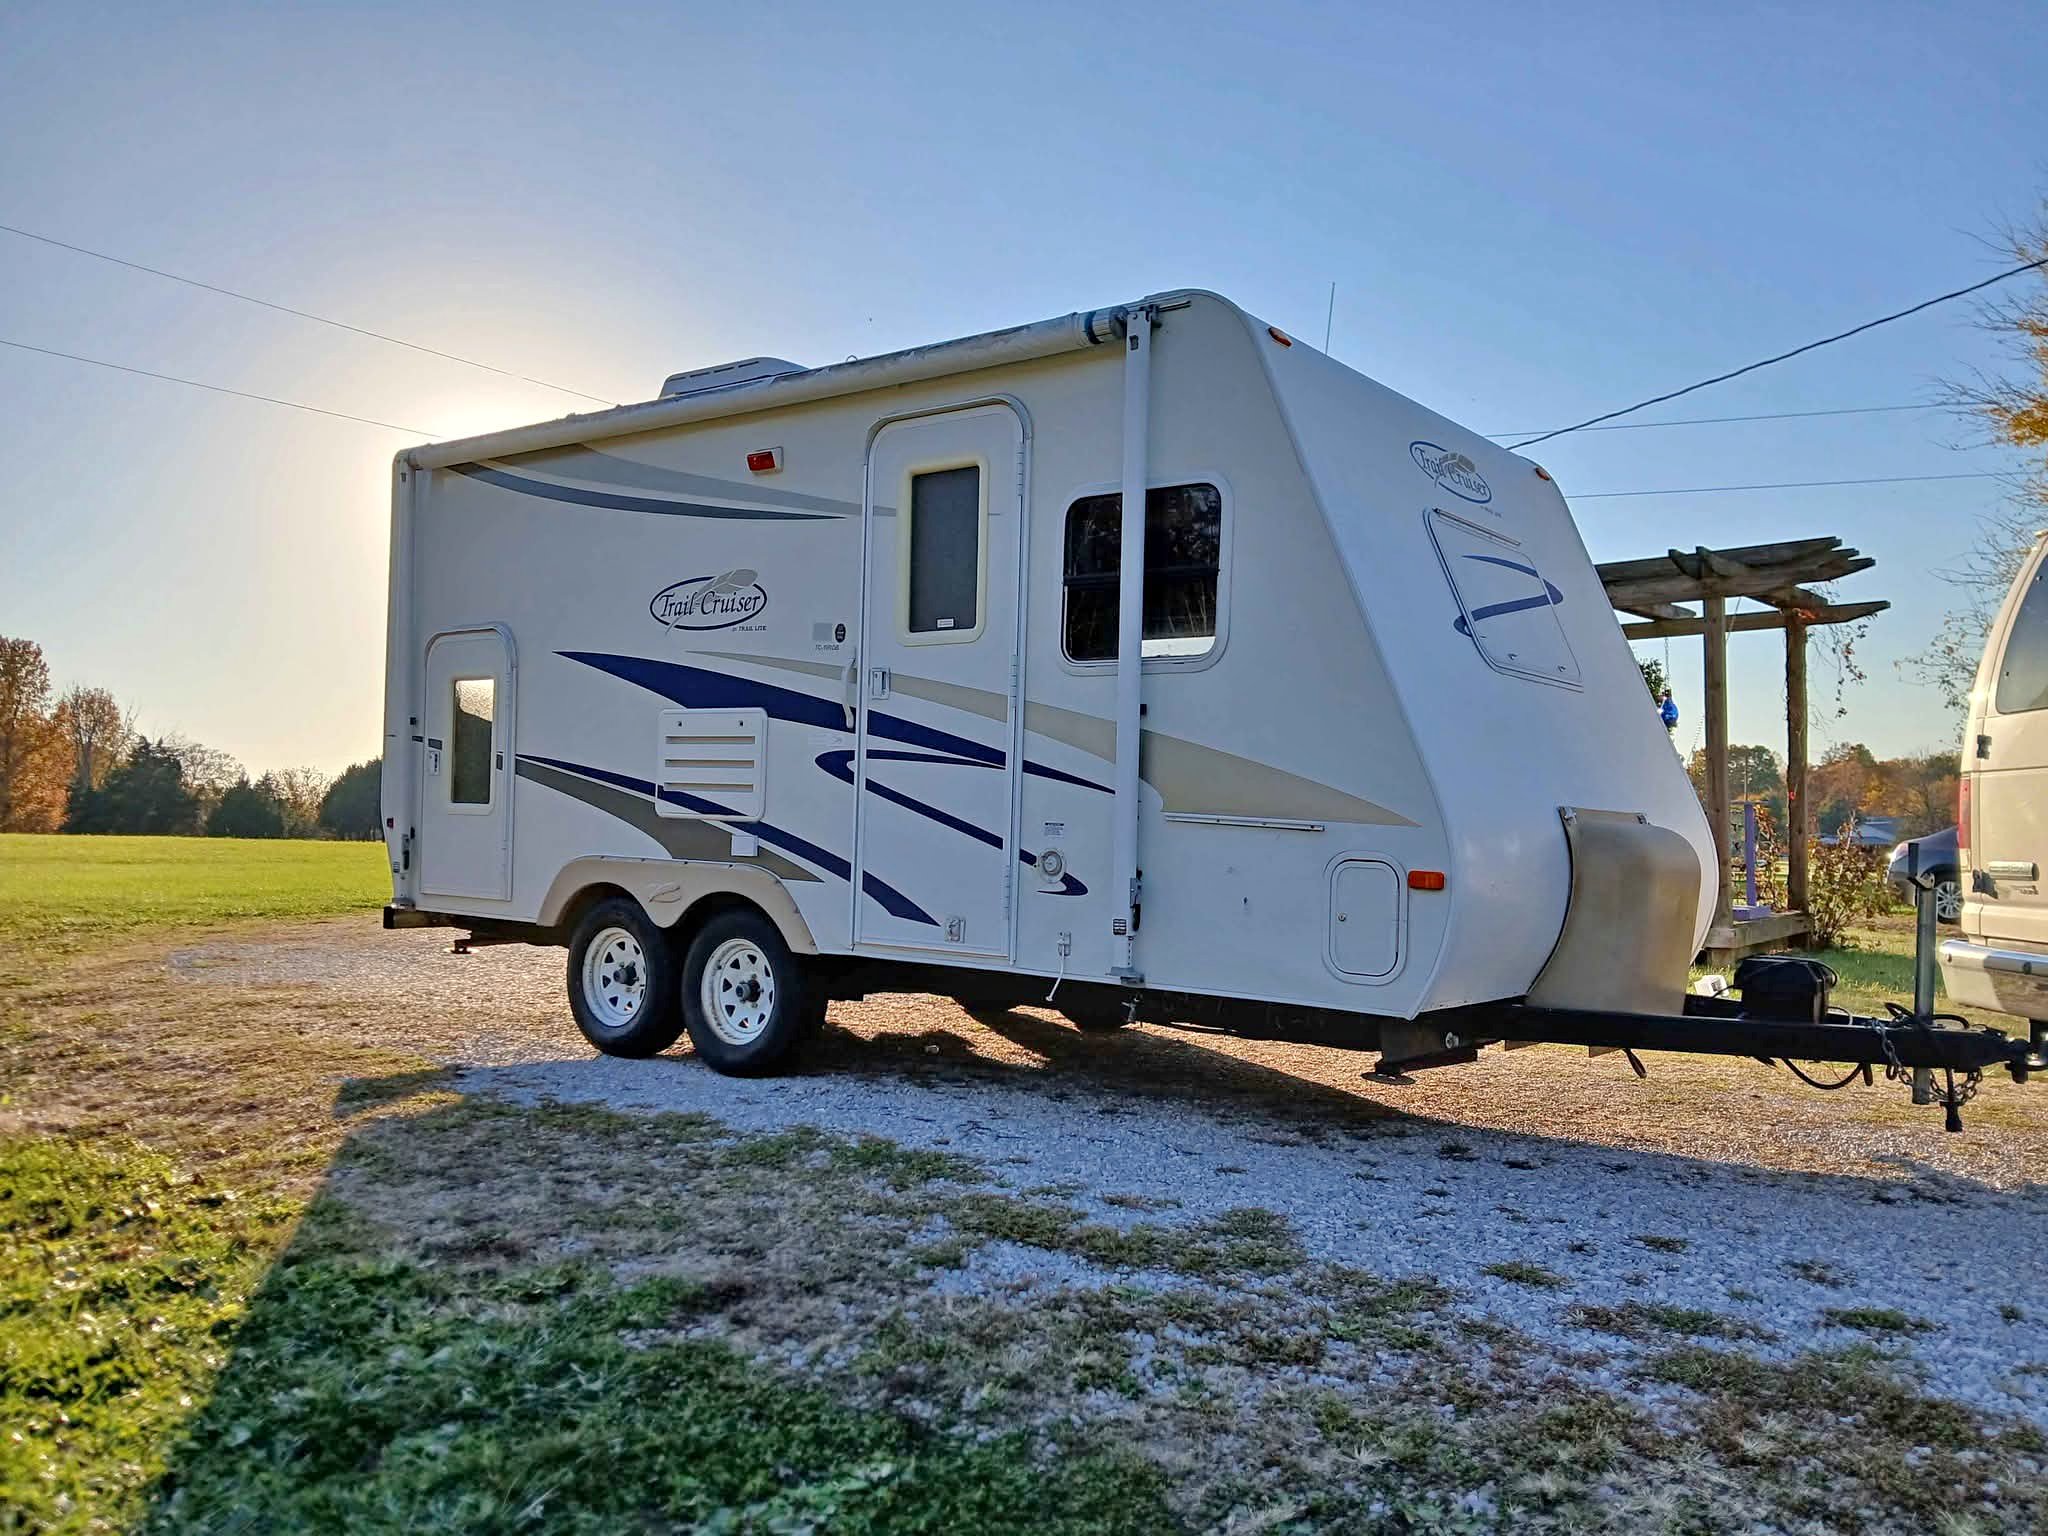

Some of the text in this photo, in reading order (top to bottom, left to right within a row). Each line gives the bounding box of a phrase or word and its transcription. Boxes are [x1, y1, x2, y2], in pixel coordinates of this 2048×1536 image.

[1414, 446, 1488, 497] Trail Cruiser
[658, 590, 761, 617] Trail Cruiser
